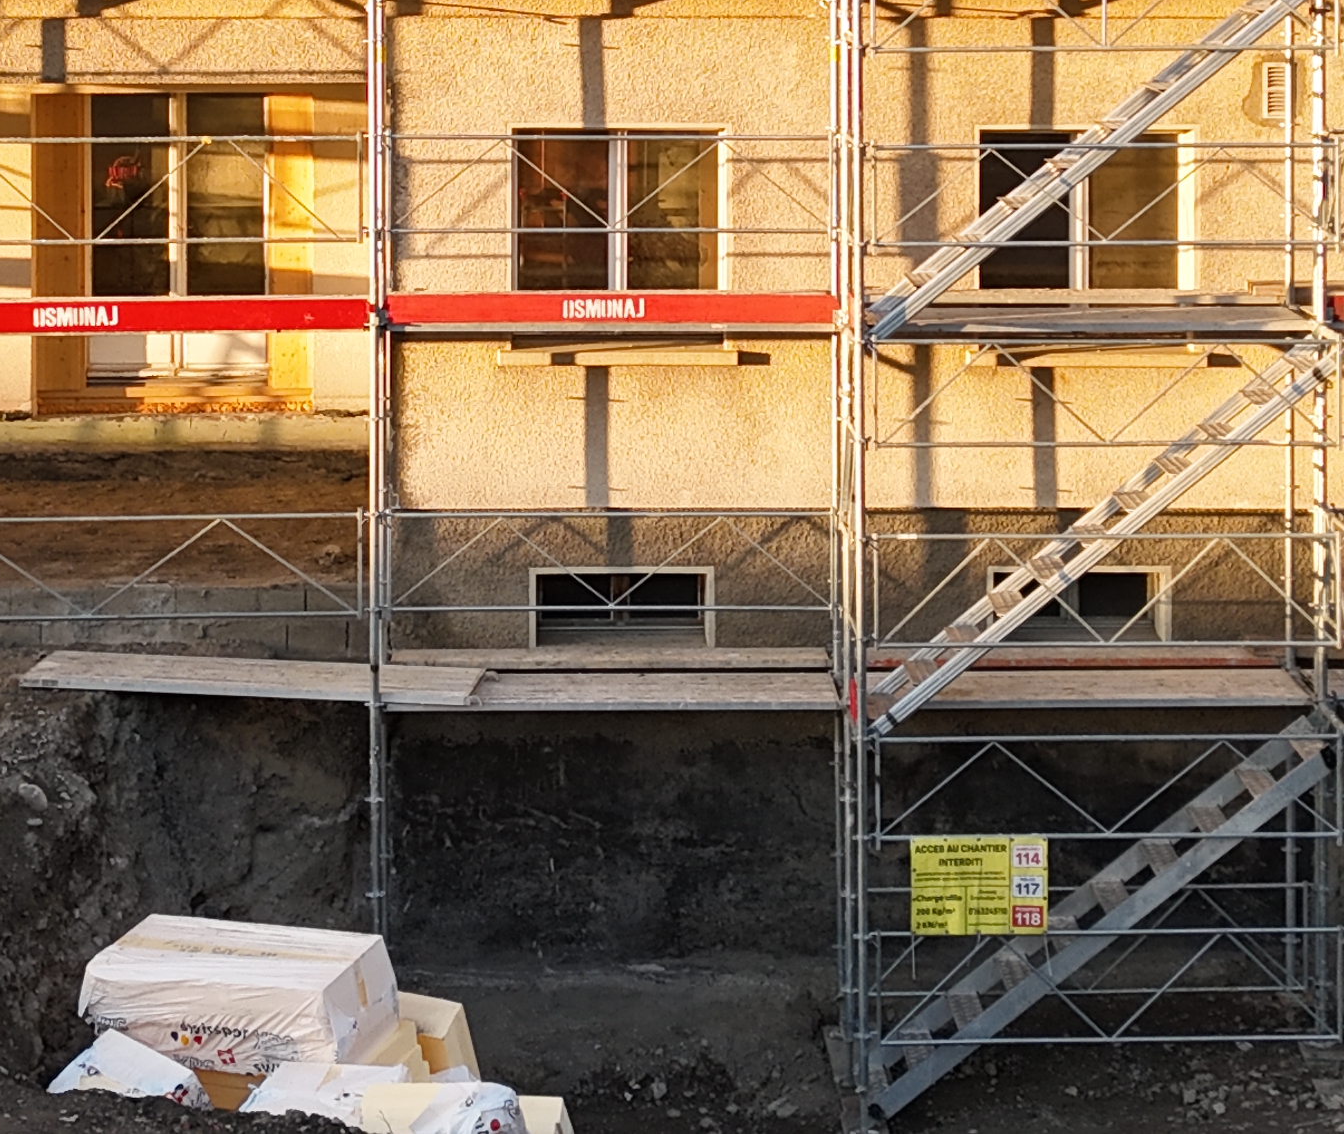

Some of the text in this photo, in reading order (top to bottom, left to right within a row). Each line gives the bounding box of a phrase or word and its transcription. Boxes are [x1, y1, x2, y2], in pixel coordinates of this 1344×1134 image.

[960, 844, 1007, 853] CHANTIER
[1016, 852, 1041, 865] 114
[1015, 883, 1040, 895] 117
[1015, 912, 1041, 926] 118
